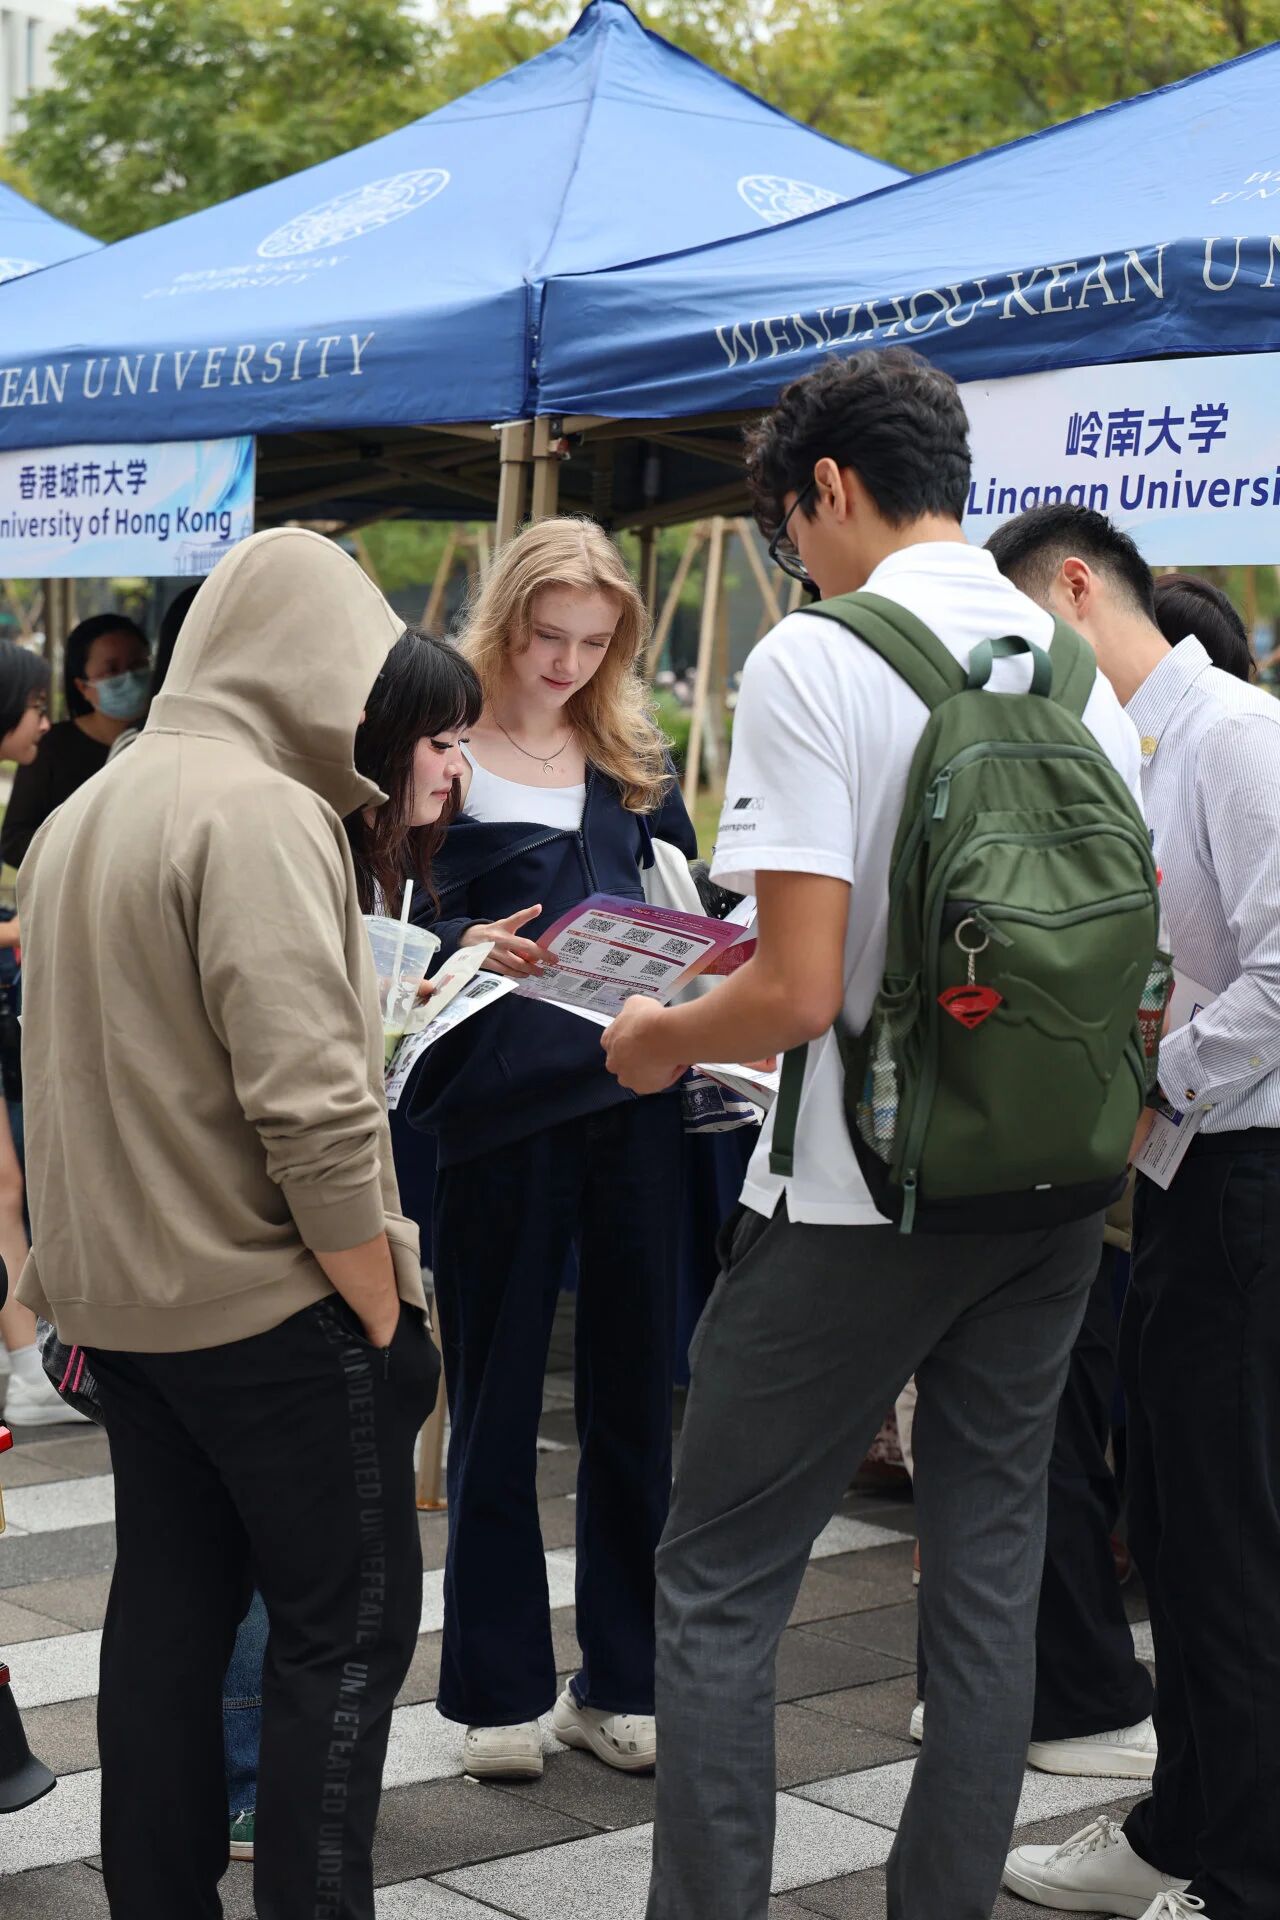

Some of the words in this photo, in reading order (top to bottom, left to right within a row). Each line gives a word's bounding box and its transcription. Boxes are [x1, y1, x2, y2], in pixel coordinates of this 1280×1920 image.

[715, 243, 1170, 368] WENZHOU-KEAN
[0, 363, 71, 408] EAN
[82, 332, 375, 399] UNIVERSITY
[1065, 402, 1229, 458] 岭南大学
[19, 459, 148, 499] 香港城市大学
[89, 507, 109, 535] of
[115, 508, 170, 541] Hong
[176, 506, 231, 540] Kong
[339, 1347, 383, 1498] UNDEFEATED
[355, 1507, 385, 1645] UNDEFEATE
[313, 1822, 343, 1920] UNDEFE
